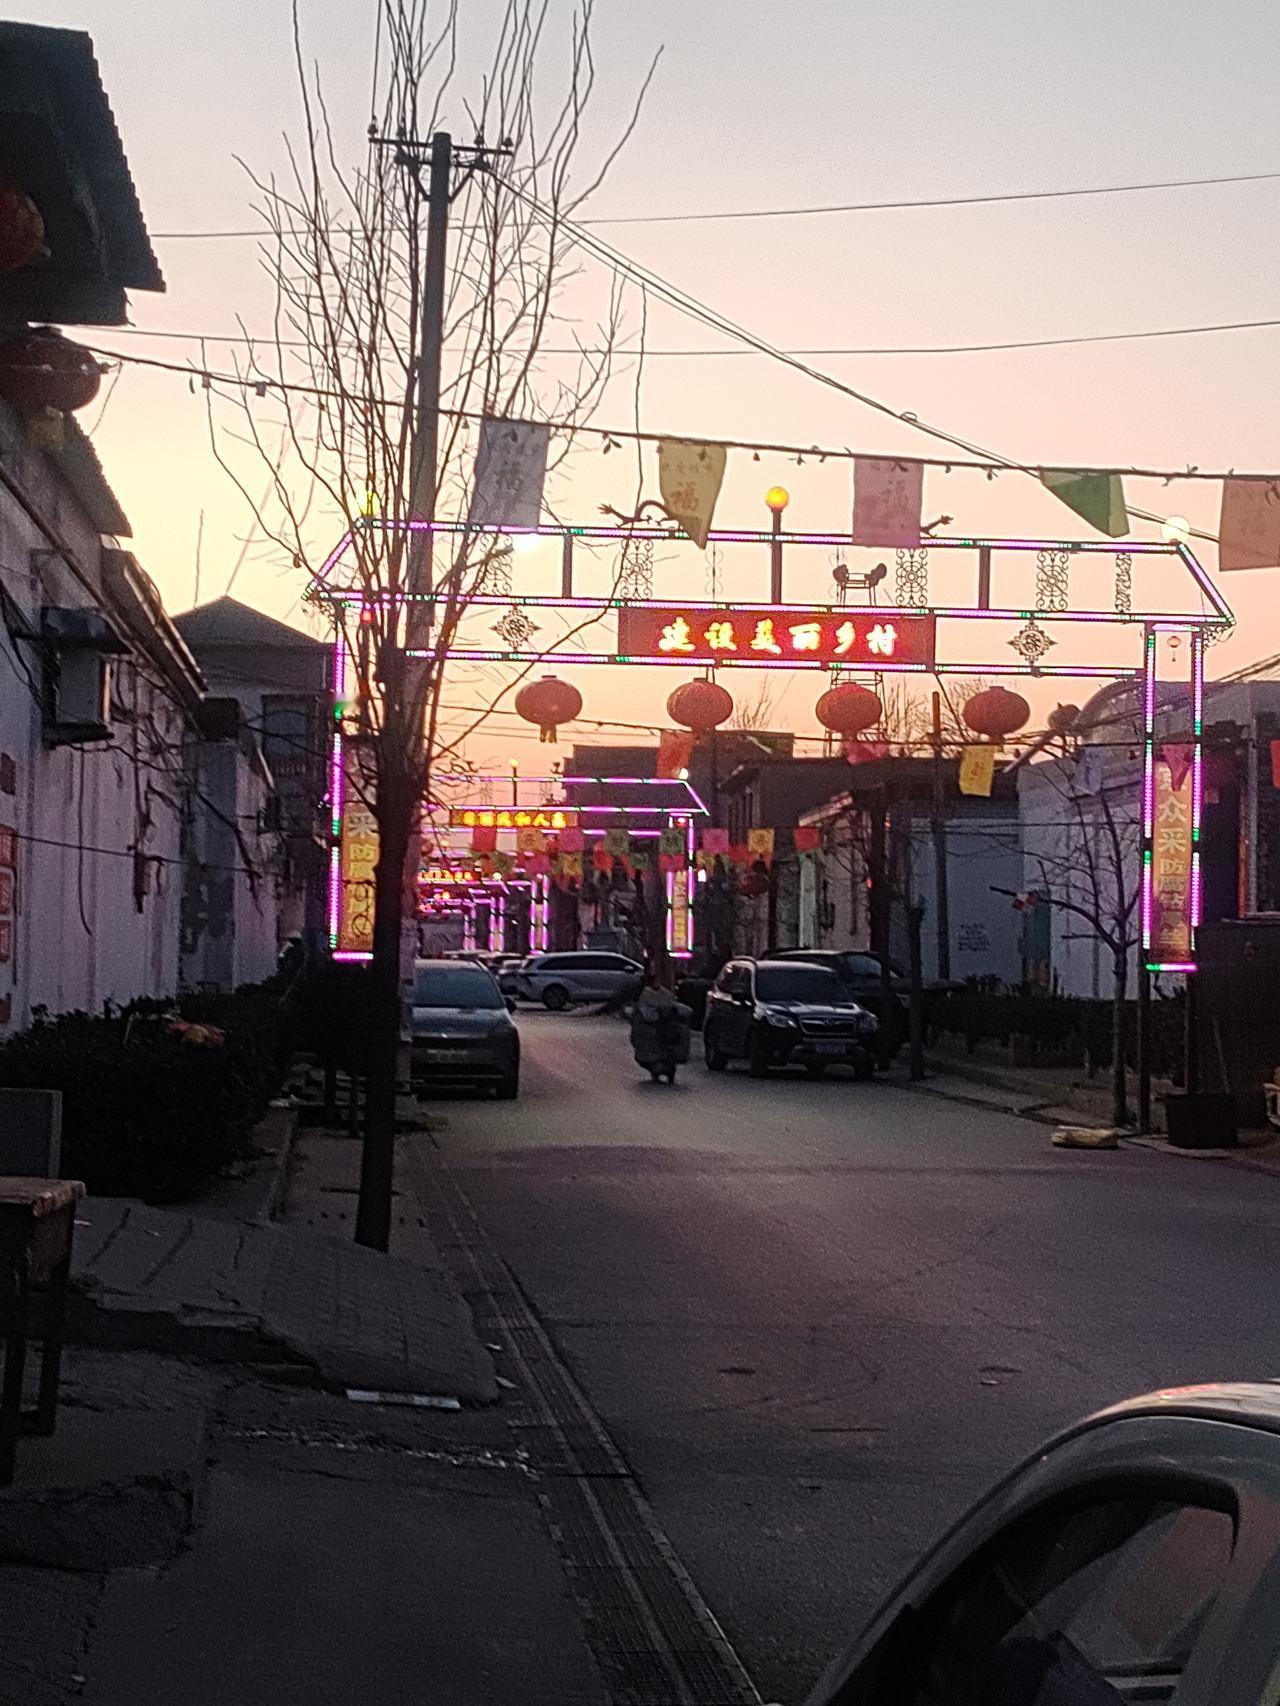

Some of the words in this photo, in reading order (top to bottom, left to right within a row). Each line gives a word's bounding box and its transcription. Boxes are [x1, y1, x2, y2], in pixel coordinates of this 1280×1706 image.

[658, 616, 897, 657] 建设美丽乡村
